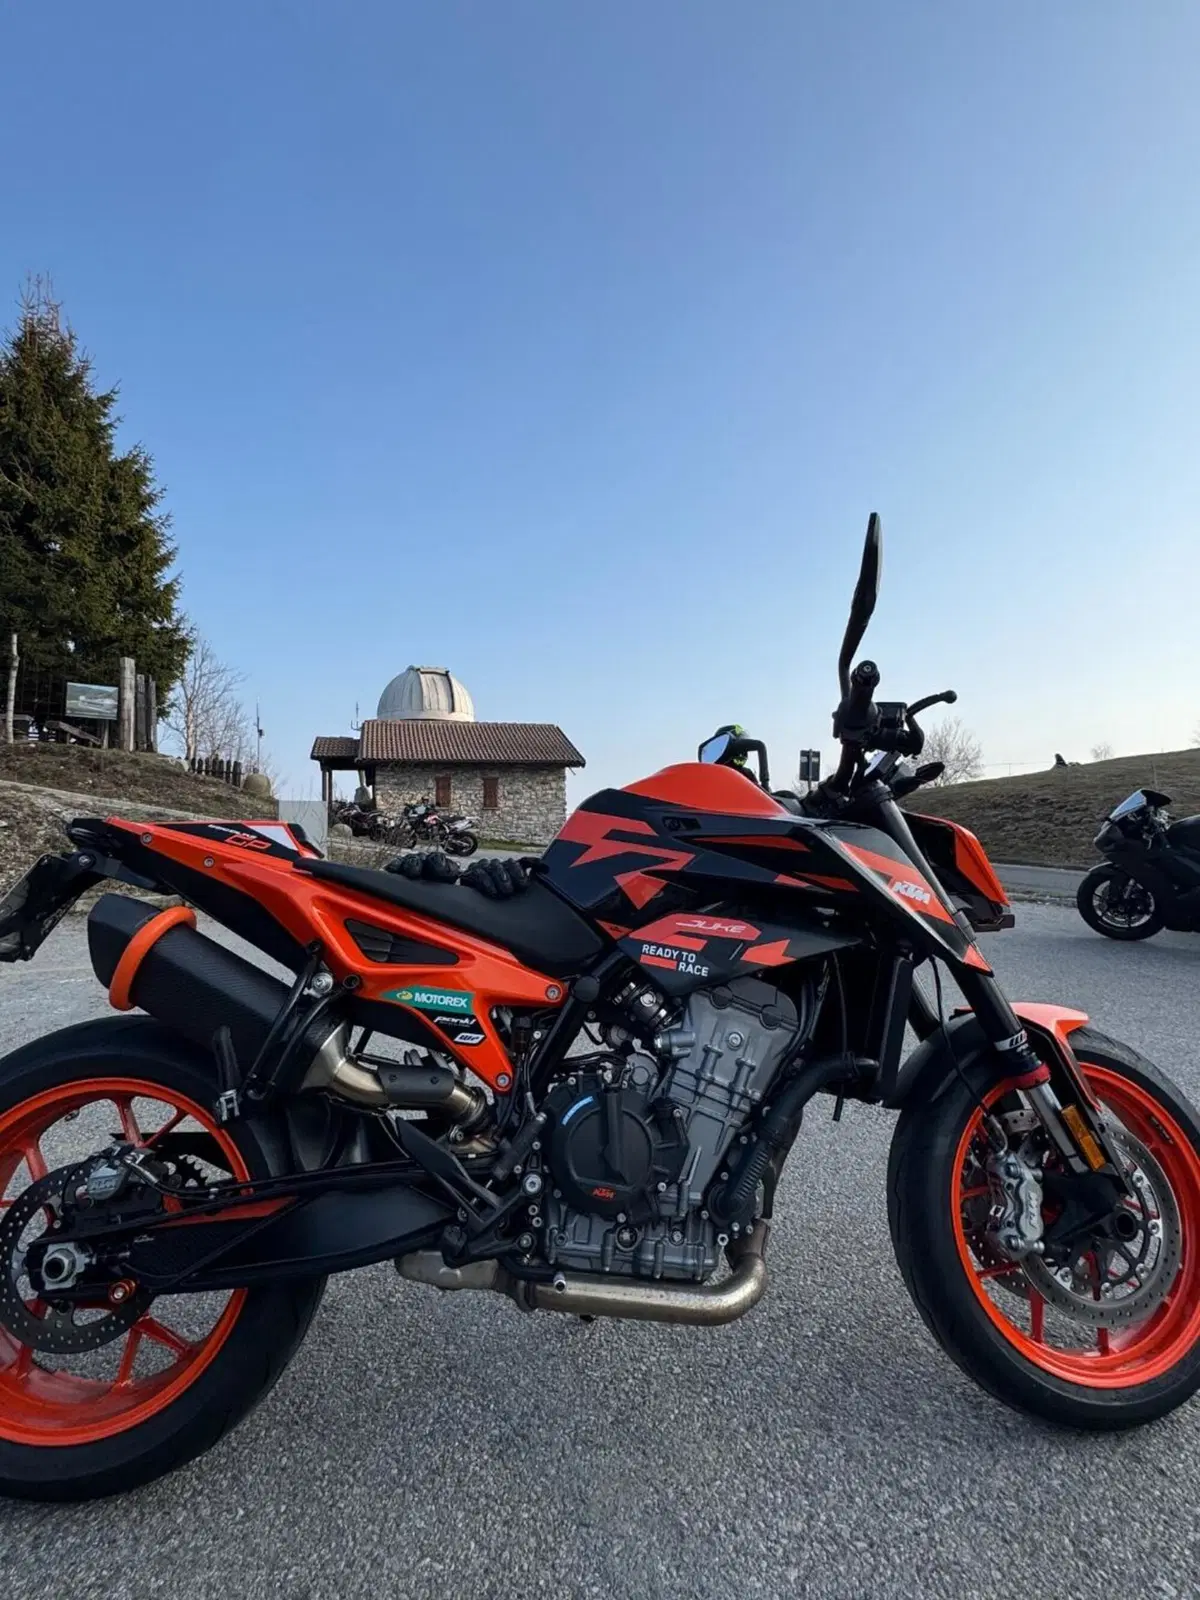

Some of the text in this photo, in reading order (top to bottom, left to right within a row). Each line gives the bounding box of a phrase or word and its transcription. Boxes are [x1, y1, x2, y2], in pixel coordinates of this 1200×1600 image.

[891, 880, 931, 905] KTM
[675, 919, 746, 933] DUKE
[641, 943, 696, 963] READY TO
[678, 961, 709, 977] RACE
[414, 991, 468, 1008] MOTOREX
